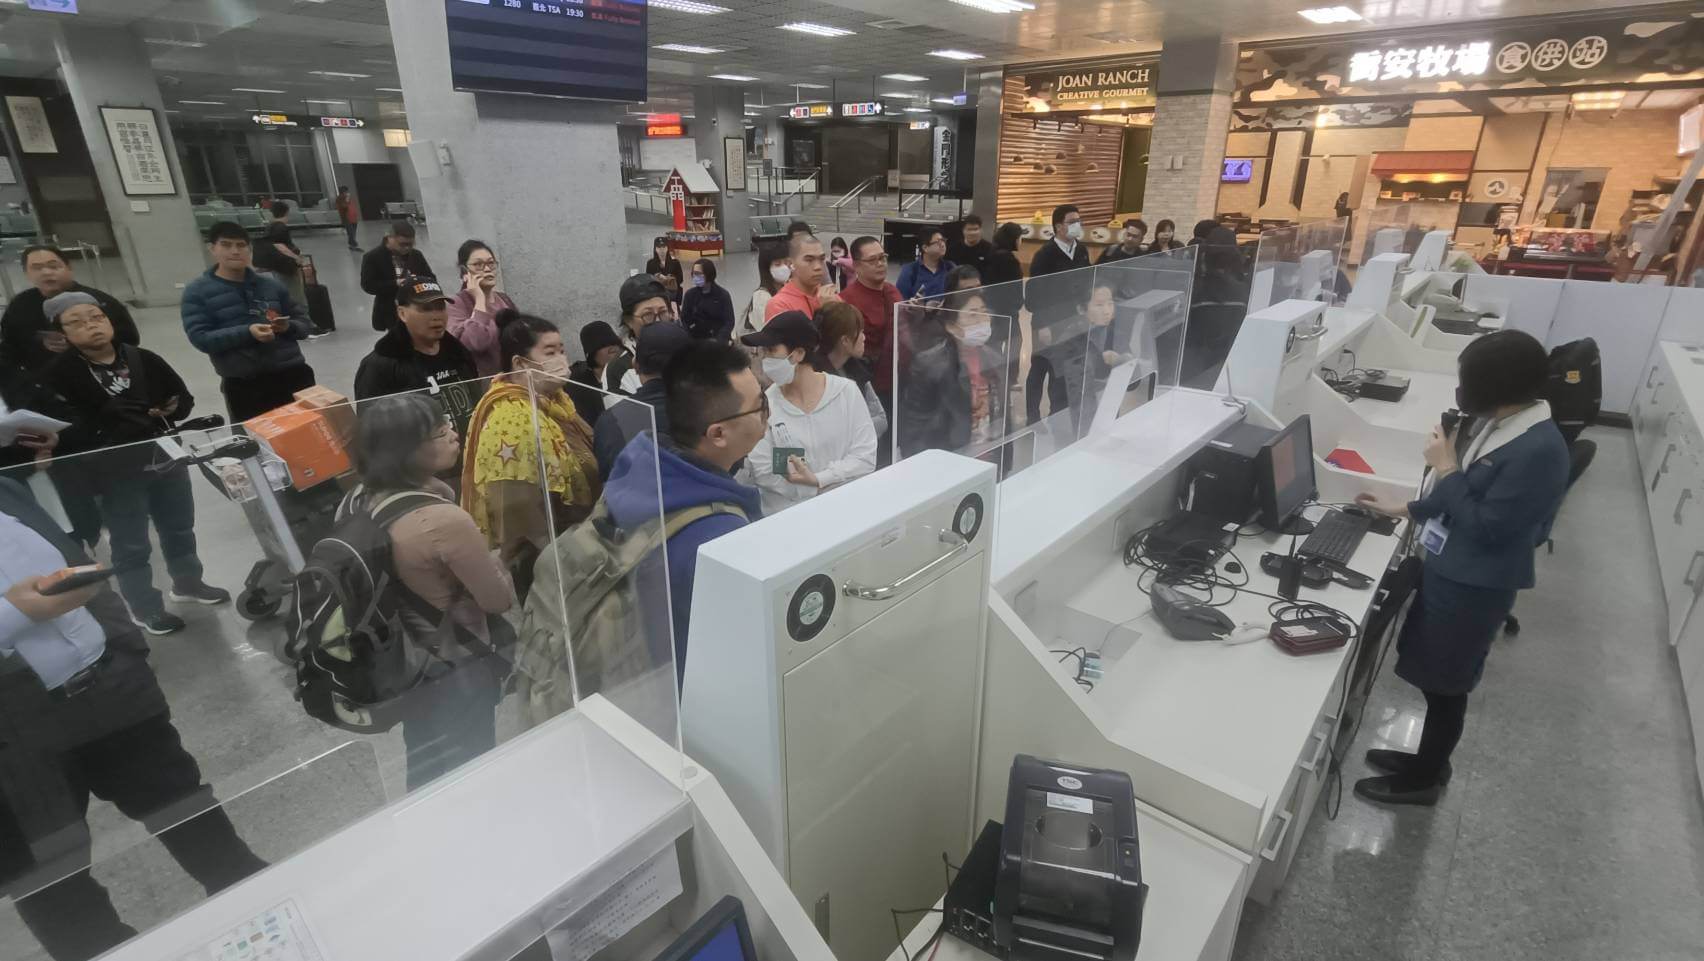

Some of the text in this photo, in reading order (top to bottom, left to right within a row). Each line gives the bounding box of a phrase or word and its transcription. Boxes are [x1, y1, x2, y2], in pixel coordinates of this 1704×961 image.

[548, 5, 561, 14] TSA
[566, 8, 584, 18] 19:30
[1057, 69, 1150, 92] JOAN RANCH
[1057, 87, 1149, 101] CREATIVE GOURMET
